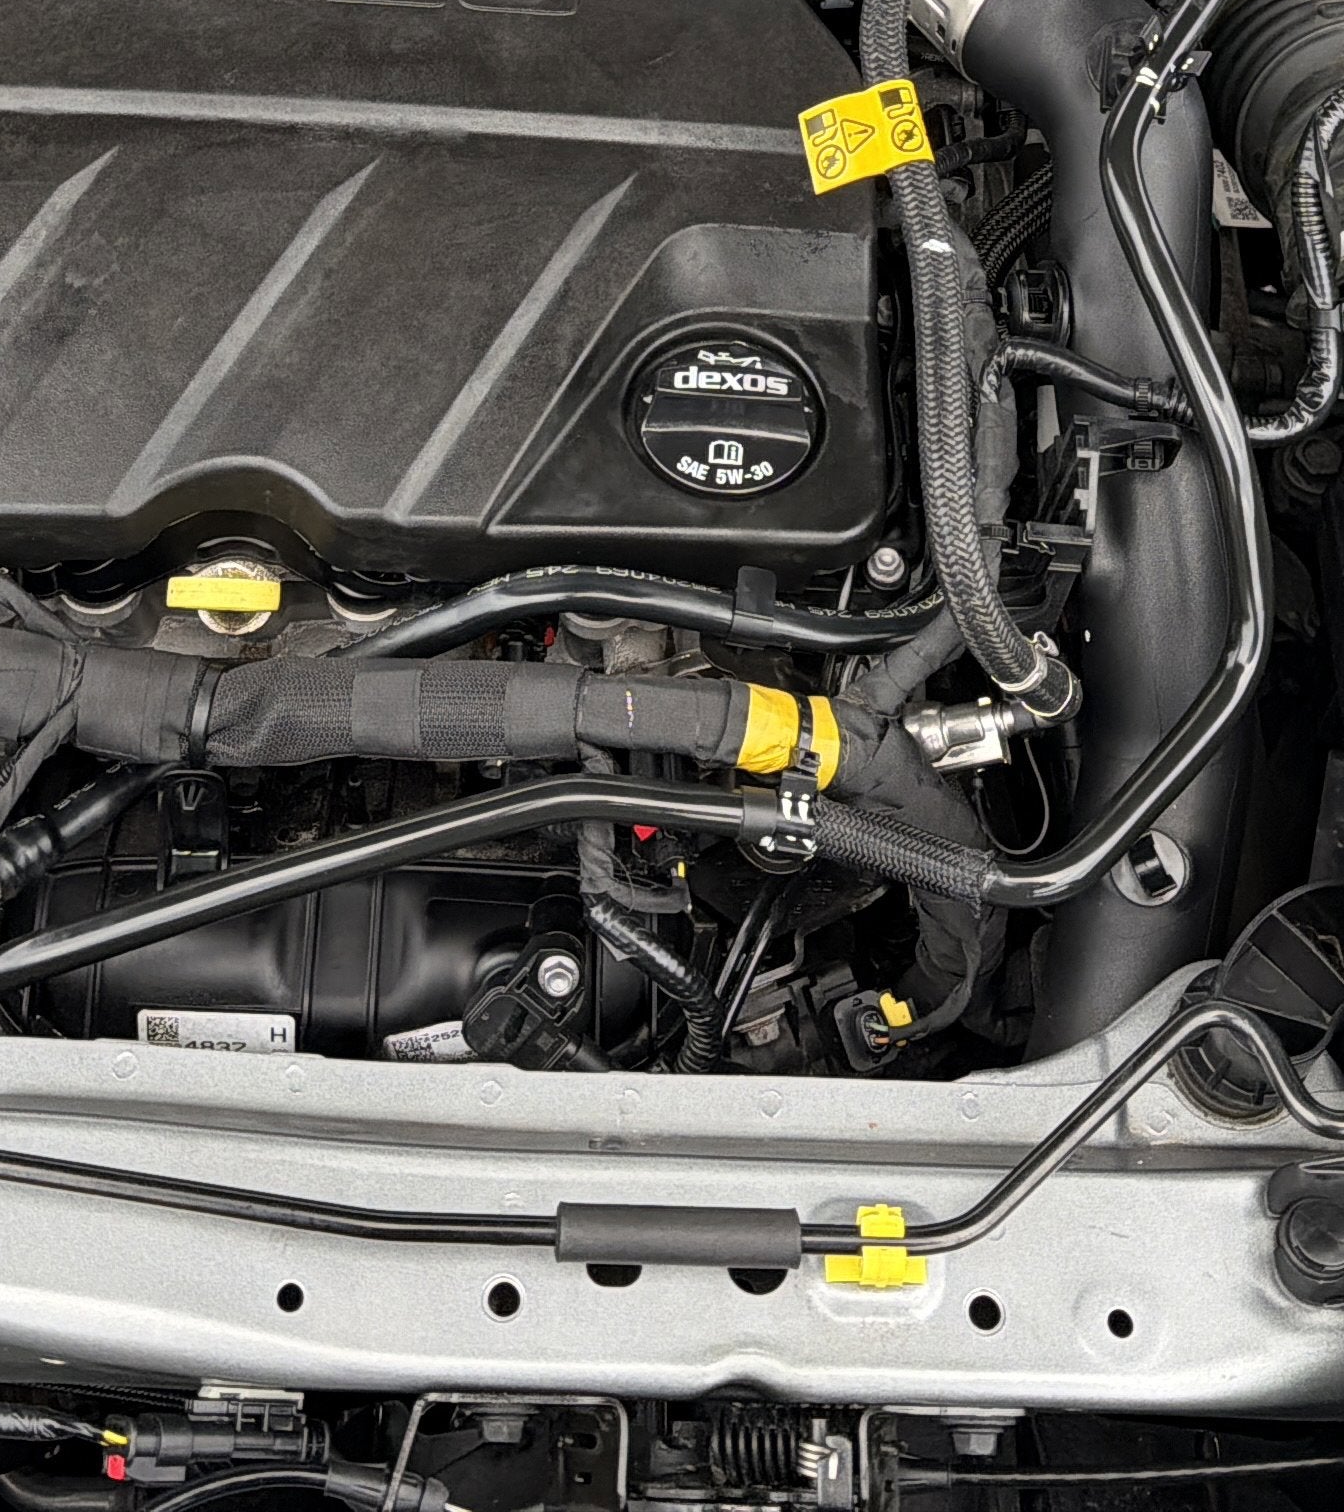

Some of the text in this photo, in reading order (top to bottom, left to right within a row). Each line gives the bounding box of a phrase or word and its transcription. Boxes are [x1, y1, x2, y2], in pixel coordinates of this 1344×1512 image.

[674, 366, 789, 396] dexos
[676, 455, 774, 485] SAE 5W-30
[270, 1027, 287, 1043] H
